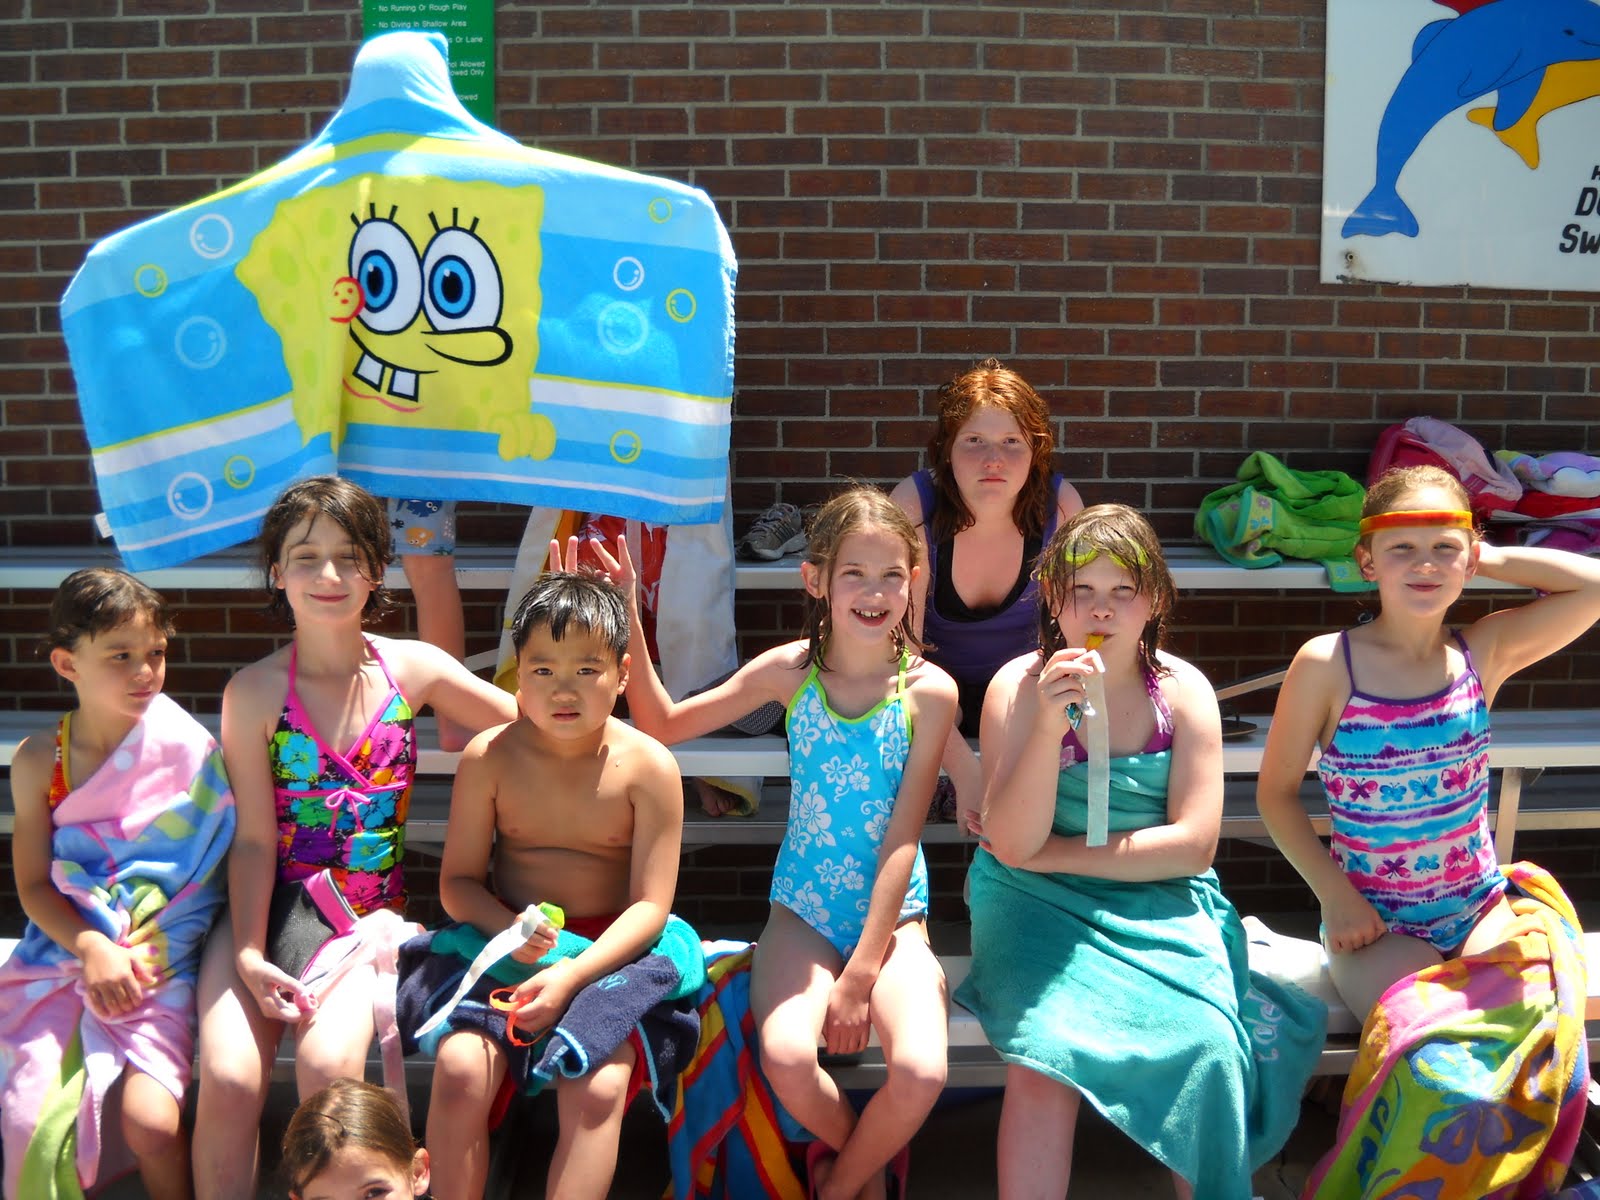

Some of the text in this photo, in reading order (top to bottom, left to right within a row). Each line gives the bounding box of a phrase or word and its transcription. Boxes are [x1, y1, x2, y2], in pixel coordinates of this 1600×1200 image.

[390, 5, 416, 13] Running
[429, 4, 450, 12] Rough
[452, 3, 467, 11] Play
[390, 21, 411, 29] Diving
[422, 20, 448, 28] Shallow
[465, 35, 483, 43] Lane
[470, 69, 485, 77] Only
